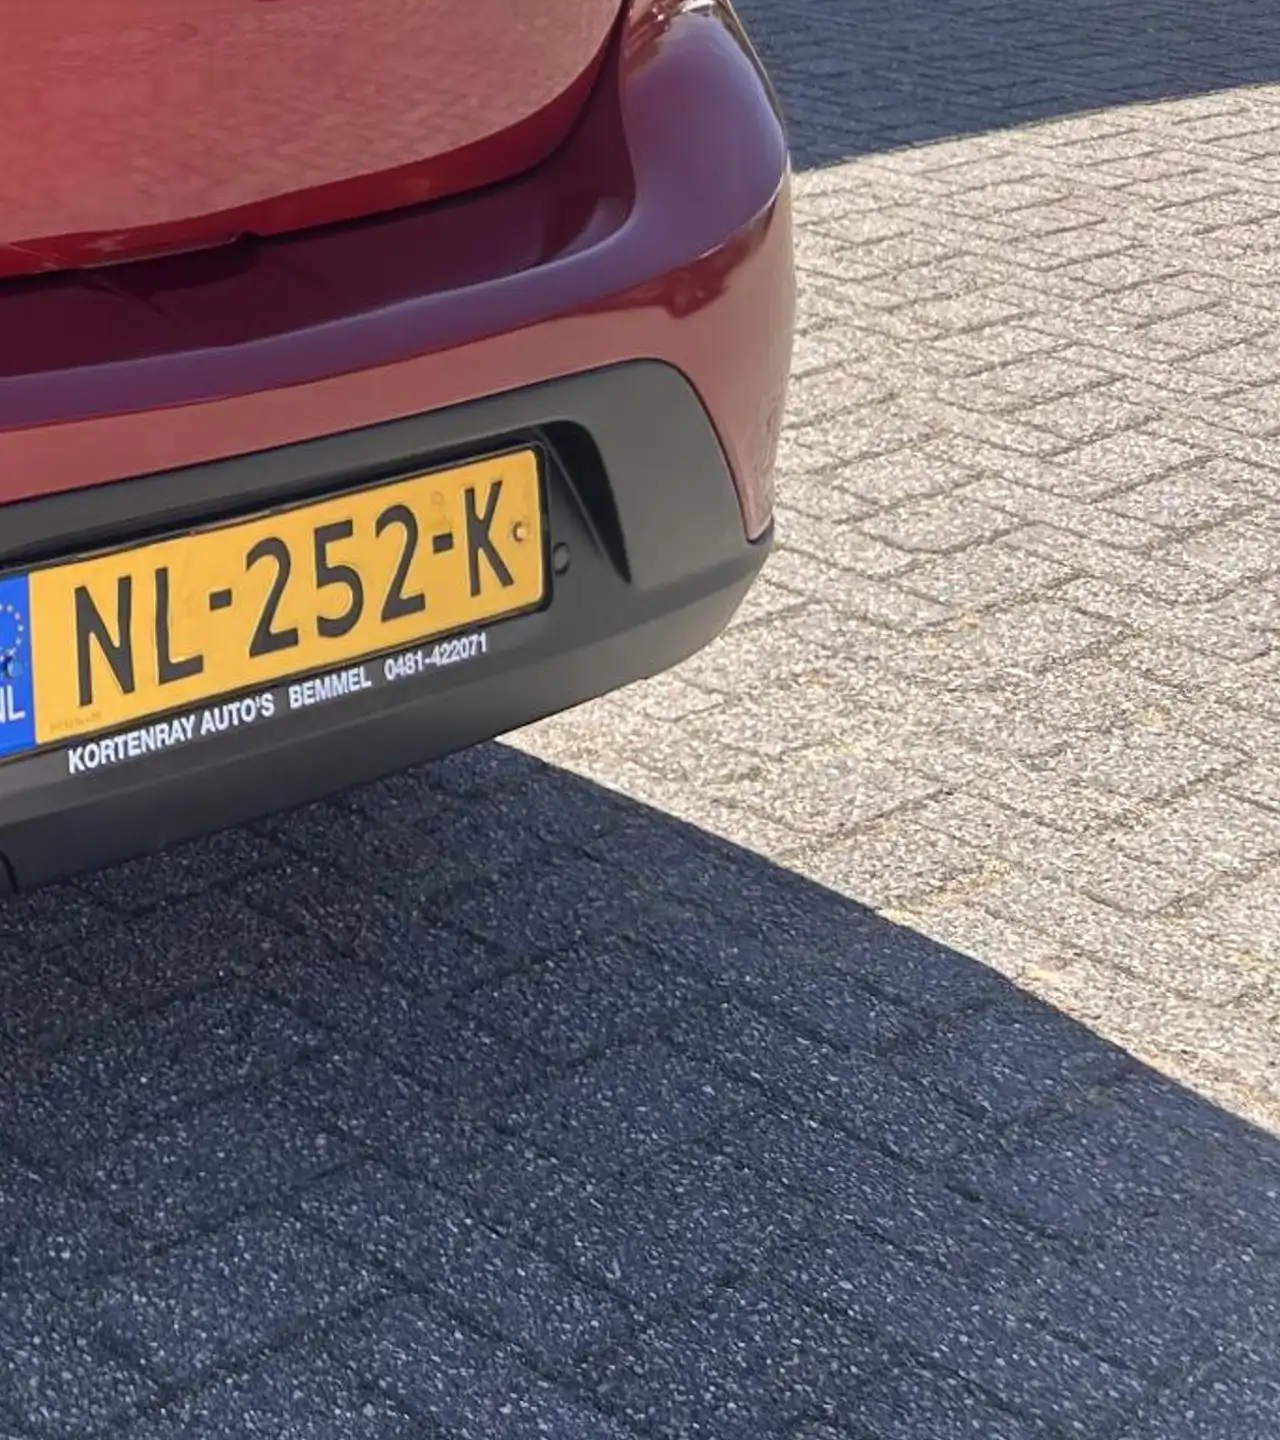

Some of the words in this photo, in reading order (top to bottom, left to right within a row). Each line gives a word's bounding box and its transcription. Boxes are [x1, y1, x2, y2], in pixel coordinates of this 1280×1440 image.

[73, 479, 515, 708] NL-252-K
[67, 714, 197, 775] KORTENRAY
[199, 692, 276, 736] AUTO'S
[289, 665, 373, 710] BEMMEL
[383, 631, 488, 681] 0481-422071
